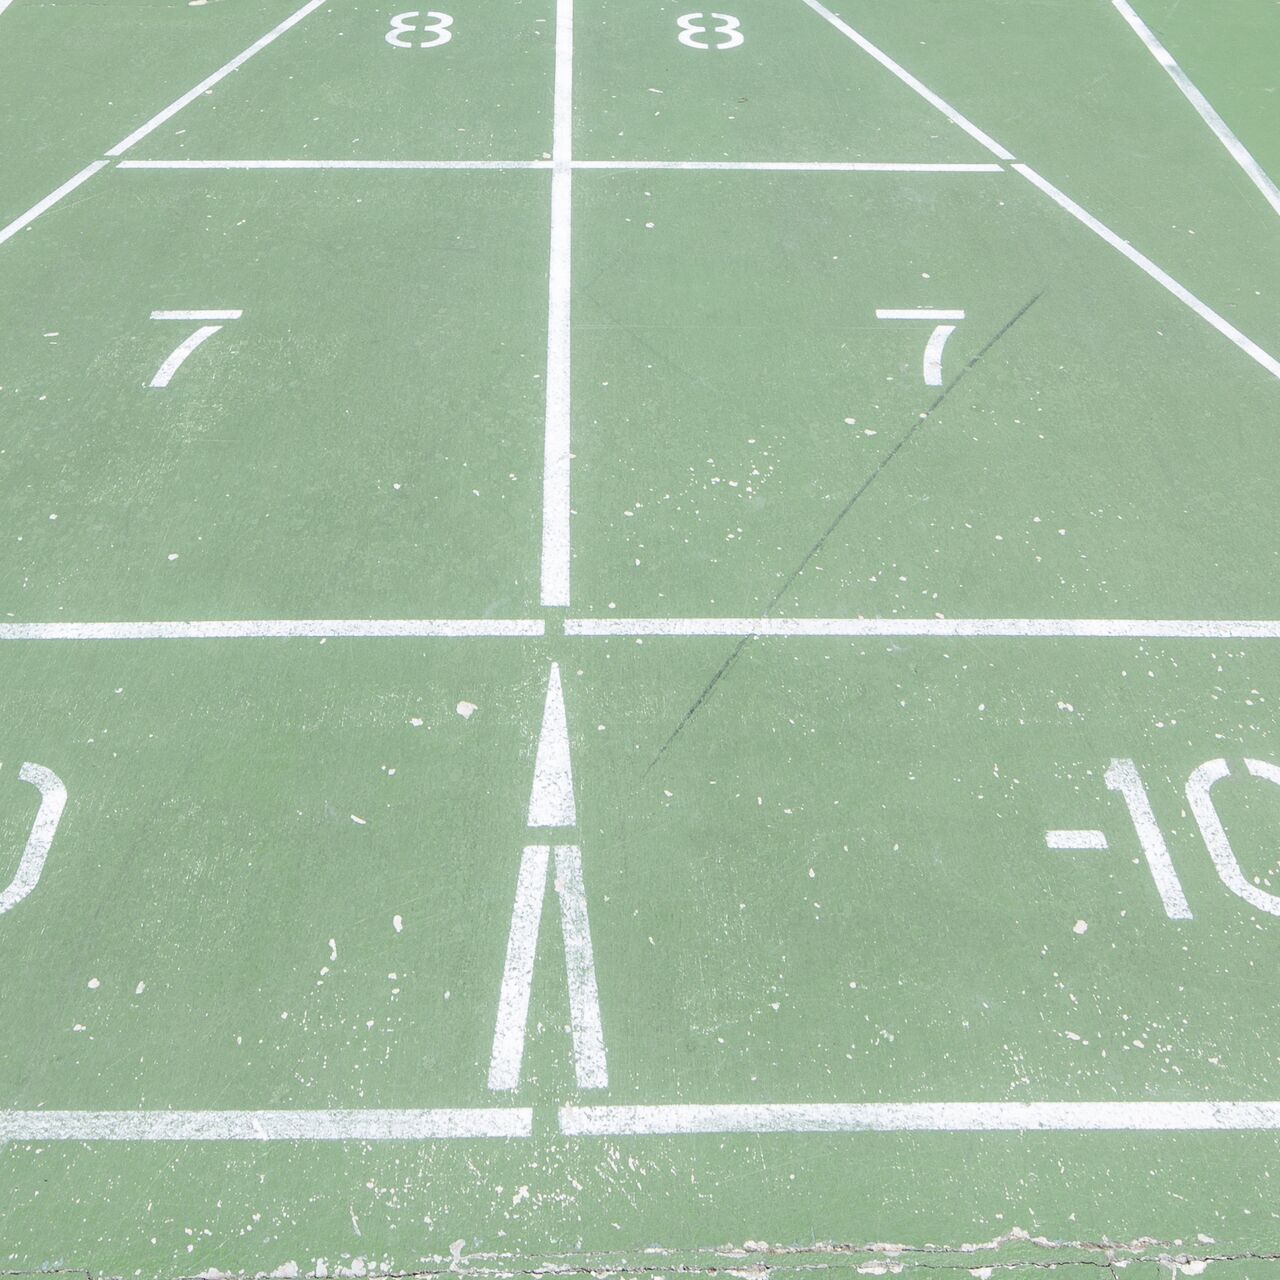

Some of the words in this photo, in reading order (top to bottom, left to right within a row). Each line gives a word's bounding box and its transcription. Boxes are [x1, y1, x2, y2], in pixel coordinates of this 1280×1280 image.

[384, 10, 454, 49] 8
[676, 12, 745, 50] 8
[149, 308, 243, 388] 7
[874, 308, 966, 387] 7
